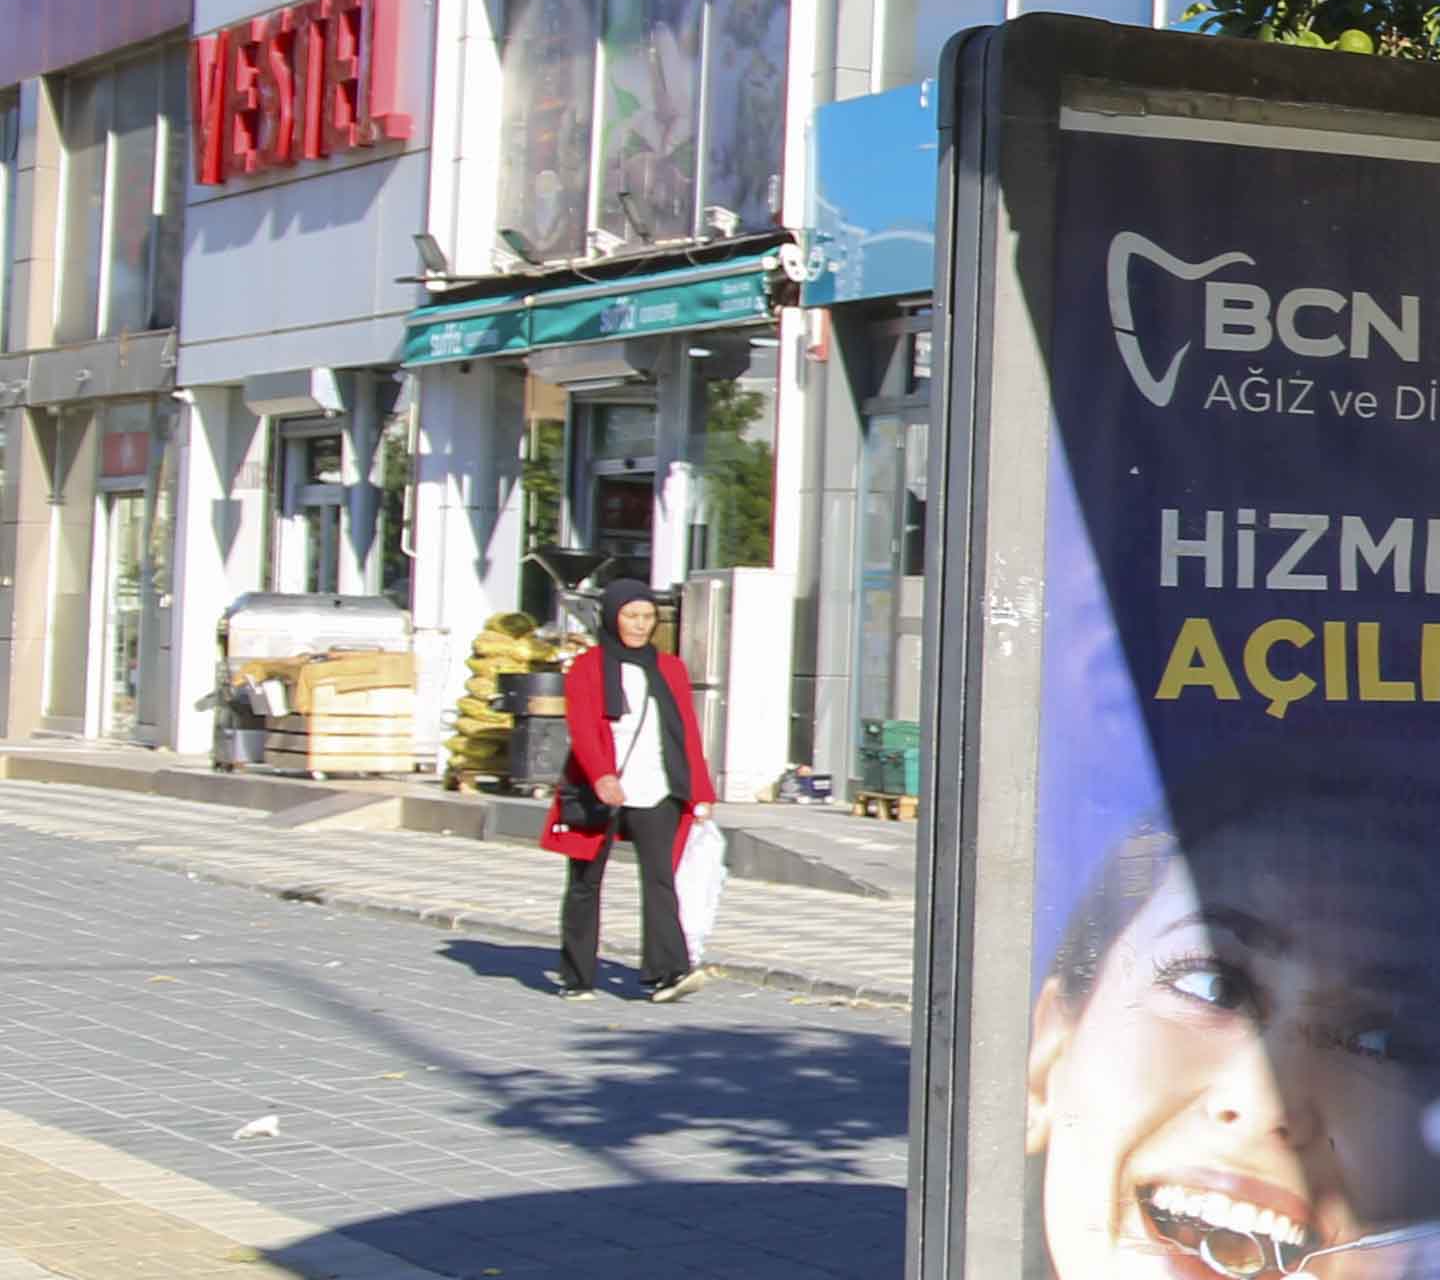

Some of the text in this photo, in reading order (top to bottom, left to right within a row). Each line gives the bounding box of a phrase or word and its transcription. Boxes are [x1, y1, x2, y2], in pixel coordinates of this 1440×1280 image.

[1205, 282, 1419, 363] BCN
[1205, 367, 1311, 416] AĞIZ
[1330, 389, 1377, 418] ve
